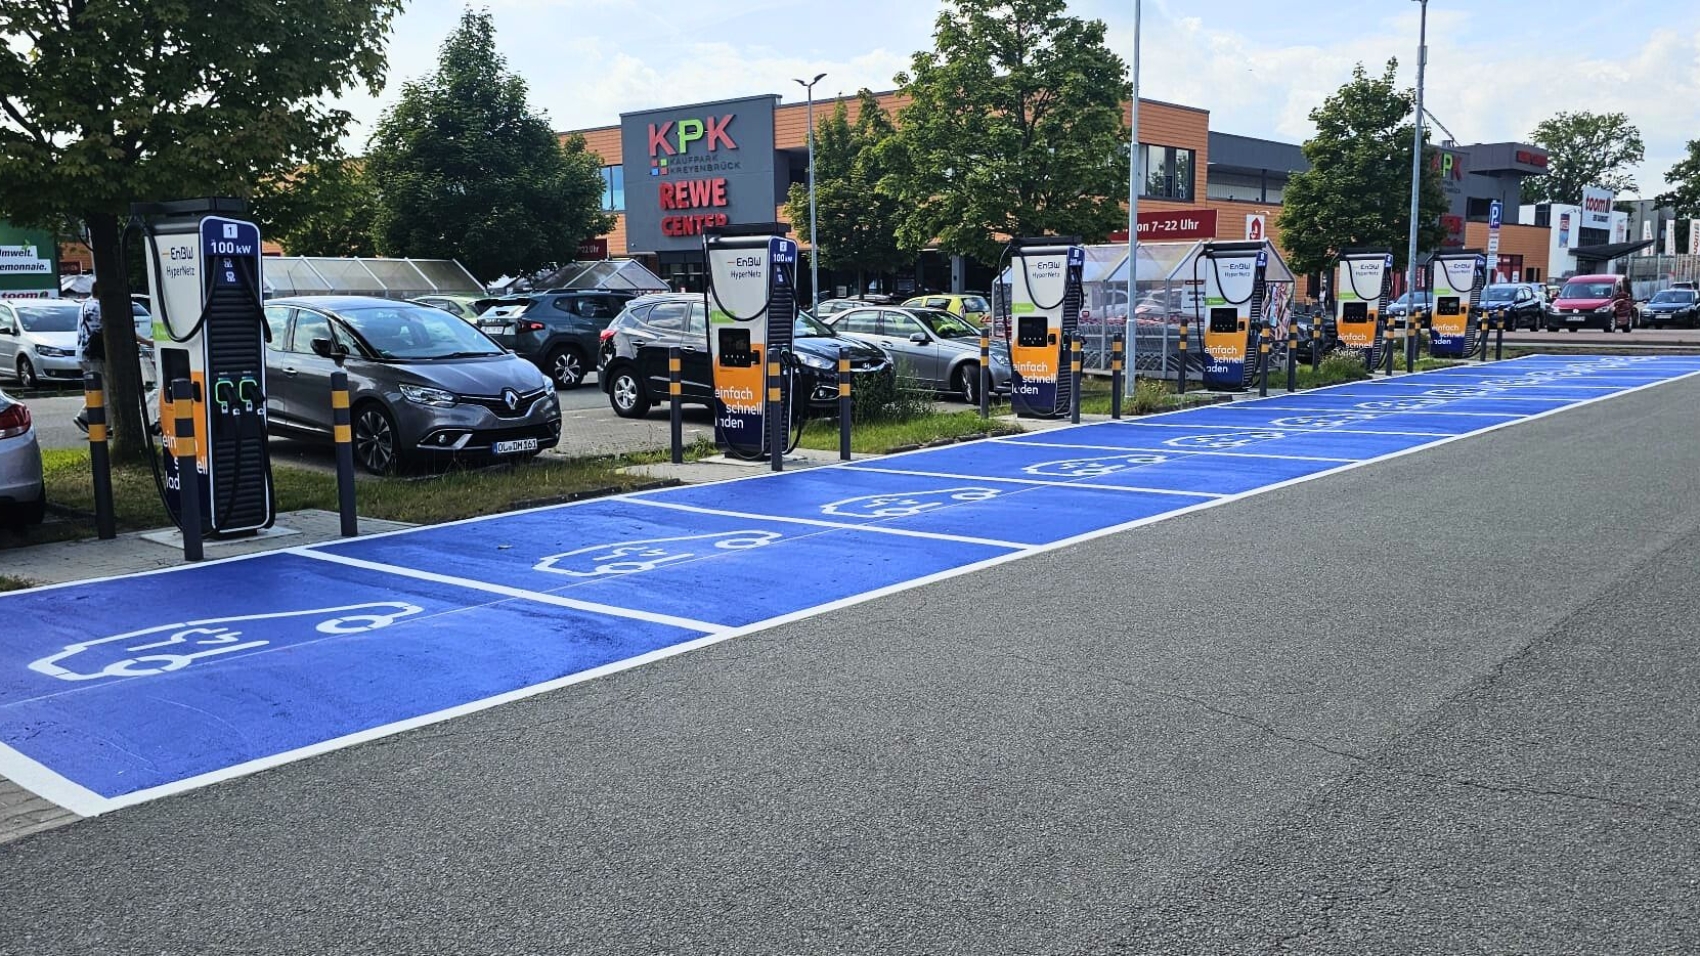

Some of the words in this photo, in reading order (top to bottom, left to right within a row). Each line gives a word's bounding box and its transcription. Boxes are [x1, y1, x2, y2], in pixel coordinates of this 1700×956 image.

[648, 114, 737, 157] KPK
[670, 154, 718, 165] KAUFPARK
[659, 177, 727, 210] REWE
[1137, 222, 1149, 232] on
[1180, 218, 1199, 230] Uhr
[171, 247, 193, 260] EnBW
[211, 241, 234, 254] 100
[236, 245, 251, 254] kW
[736, 257, 761, 267] EnBW
[773, 254, 784, 262] 100
[1037, 261, 1060, 269] EnBW
[166, 266, 195, 279] HyperNetz
[730, 270, 761, 280] HyperNetz
[1204, 344, 1238, 354] einfach
[1013, 361, 1048, 373] einfach
[1206, 363, 1228, 373] aden
[1022, 372, 1057, 384] schnell
[715, 385, 754, 400] einfach
[726, 400, 762, 416] schnell
